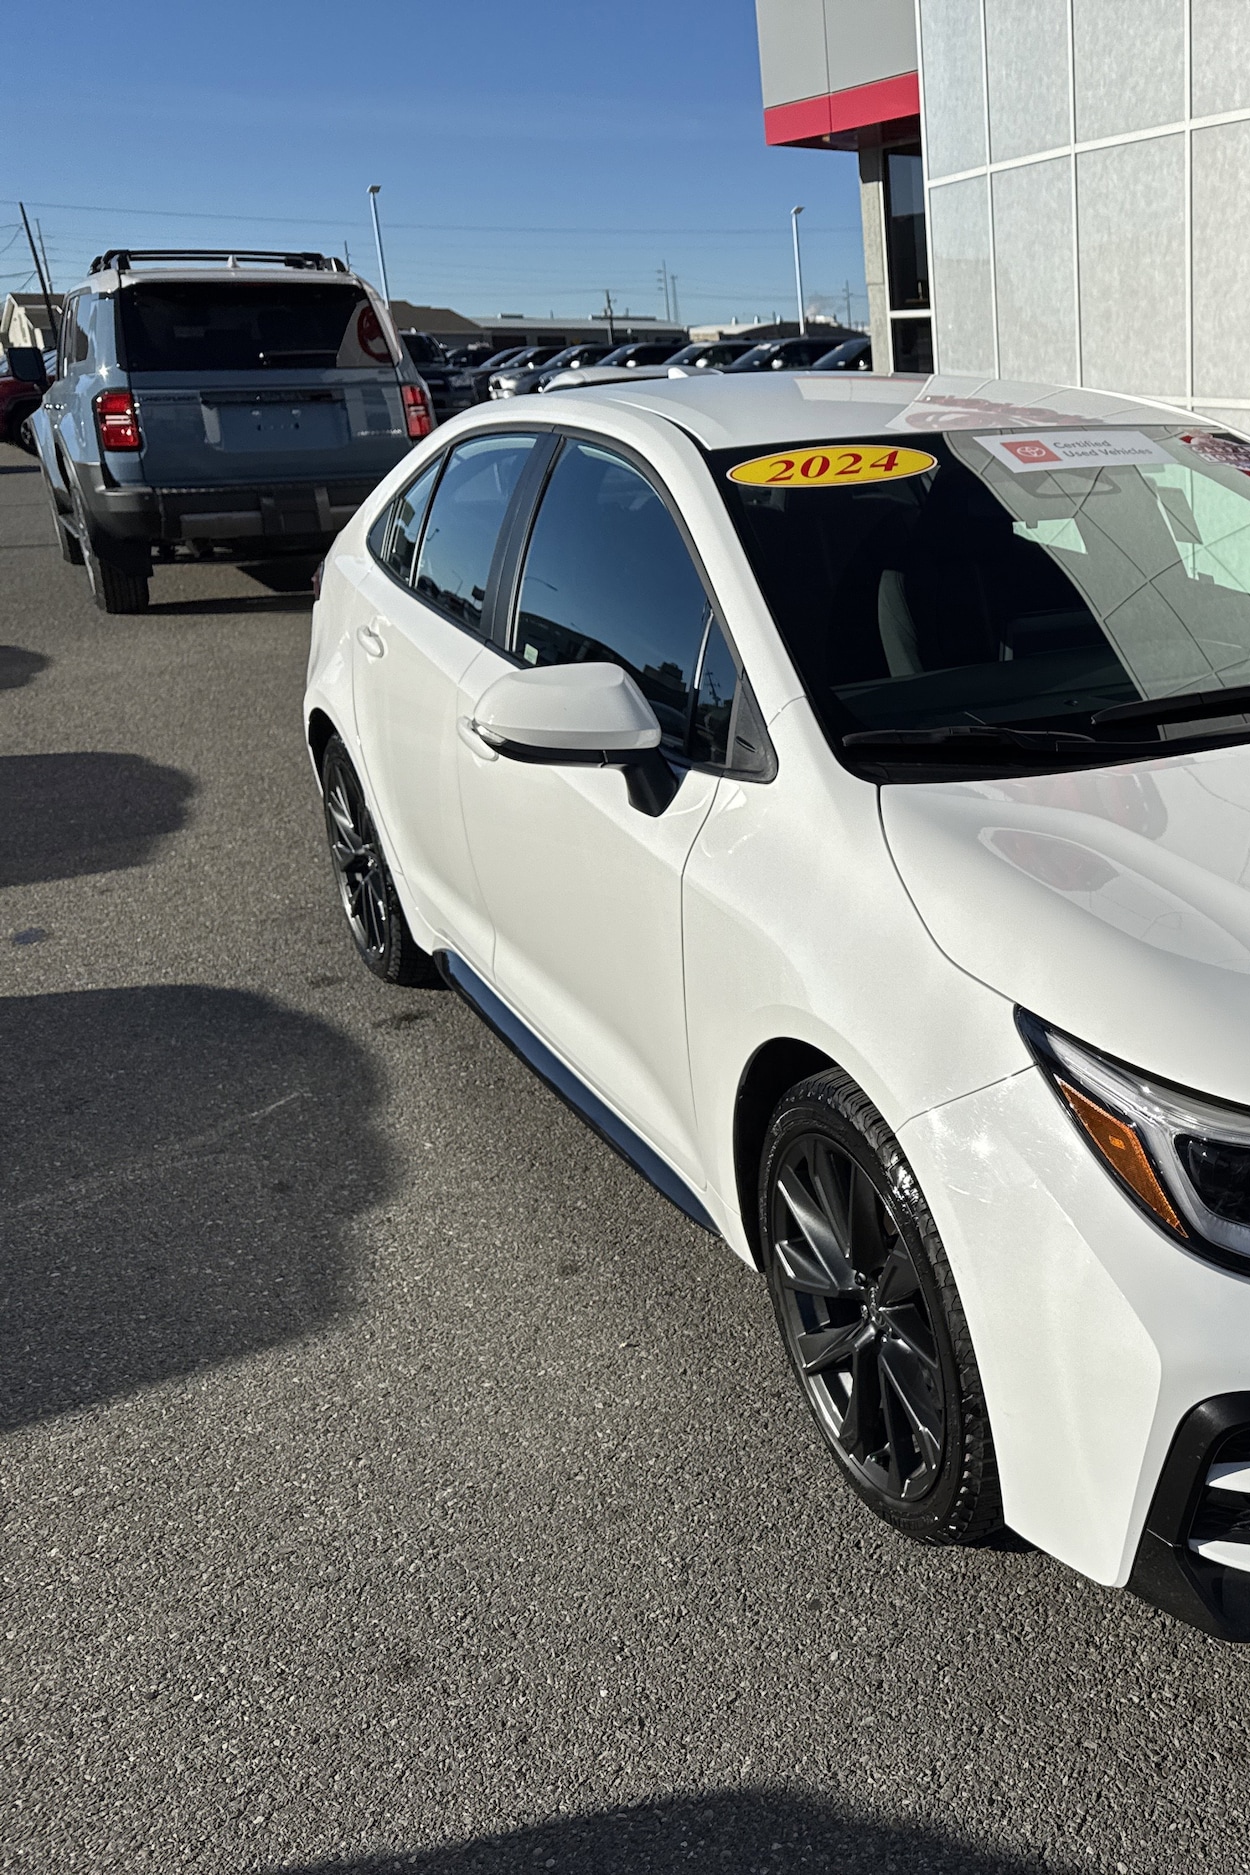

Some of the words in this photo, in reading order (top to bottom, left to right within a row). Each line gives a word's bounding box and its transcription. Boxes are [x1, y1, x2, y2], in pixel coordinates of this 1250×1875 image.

[1053, 440, 1112, 449] Certified
[1062, 449, 1099, 457] Used
[1100, 448, 1153, 456] Vehicles
[765, 450, 899, 483] 2024
